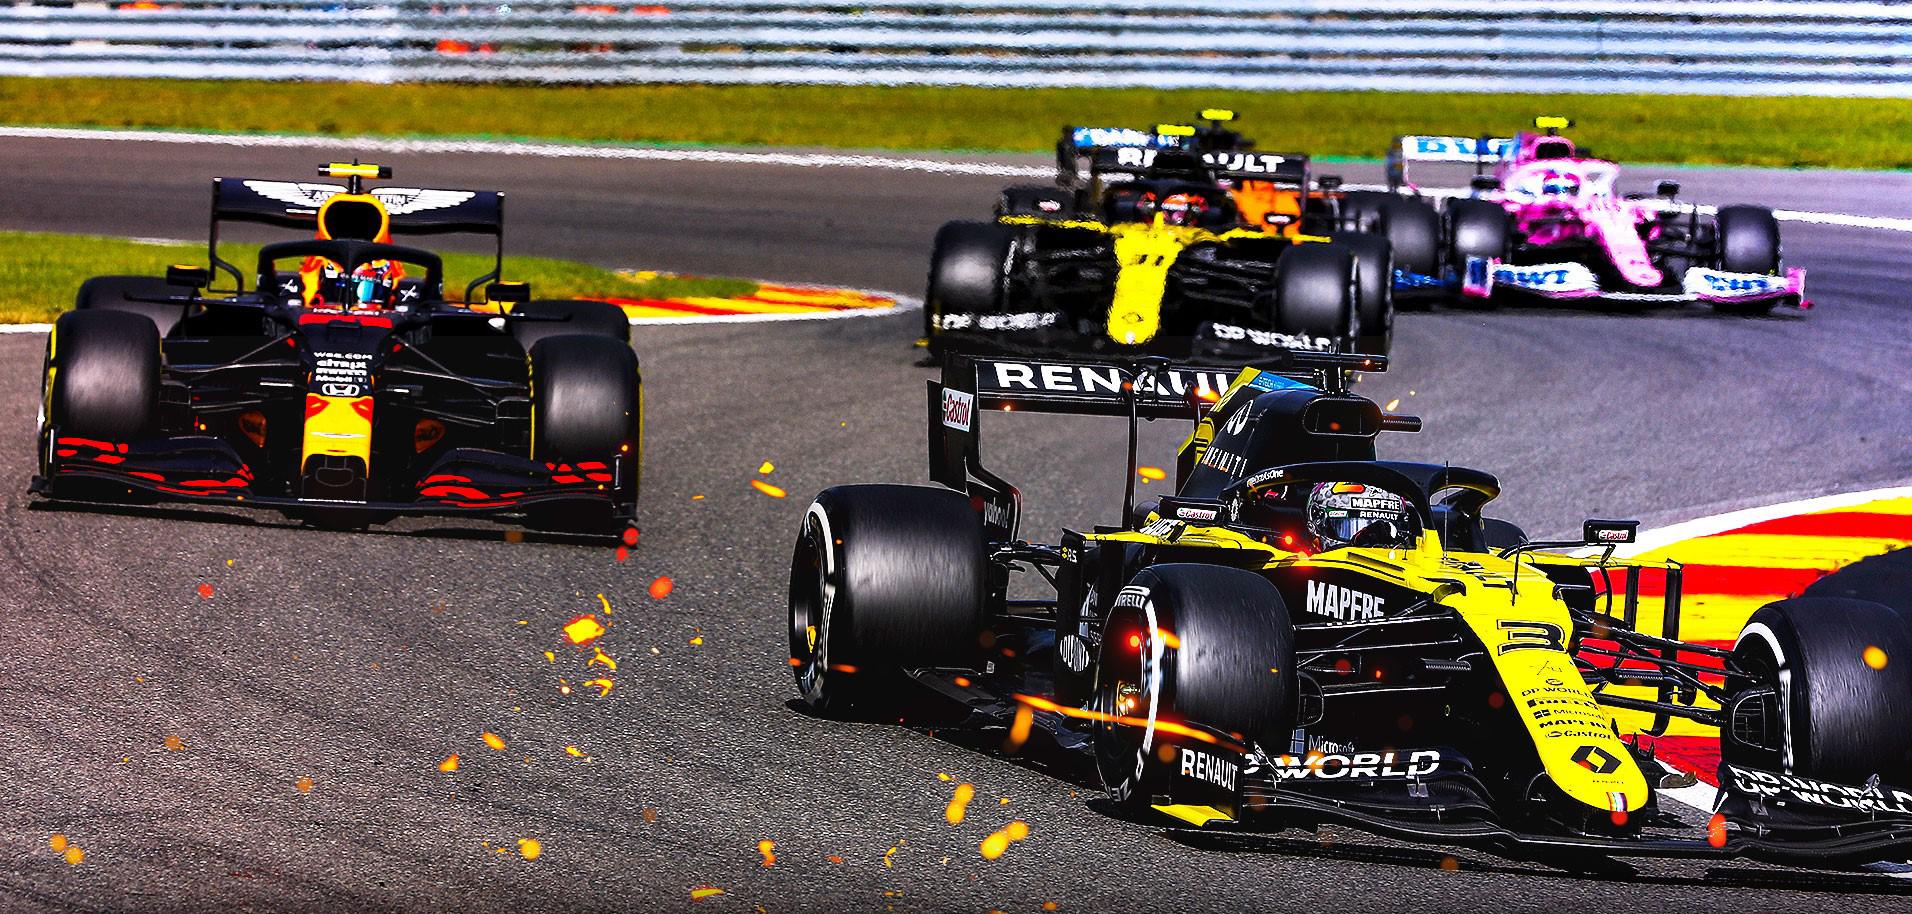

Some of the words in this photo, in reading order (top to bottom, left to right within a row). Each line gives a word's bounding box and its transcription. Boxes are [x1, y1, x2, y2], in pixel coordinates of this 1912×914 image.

[946, 393, 970, 426] Castrol
[1185, 510, 1215, 521] Castrol
[1351, 498, 1400, 511] MAPFRE
[1360, 511, 1399, 521] RENAULT
[1306, 579, 1385, 621] MAPFRE
[1496, 619, 1568, 656] 3
[1308, 734, 1355, 754] Microsoft
[1563, 730, 1612, 740] Castrol
[1181, 748, 1239, 793] RENAULT
[1274, 750, 1441, 780] WORLD
